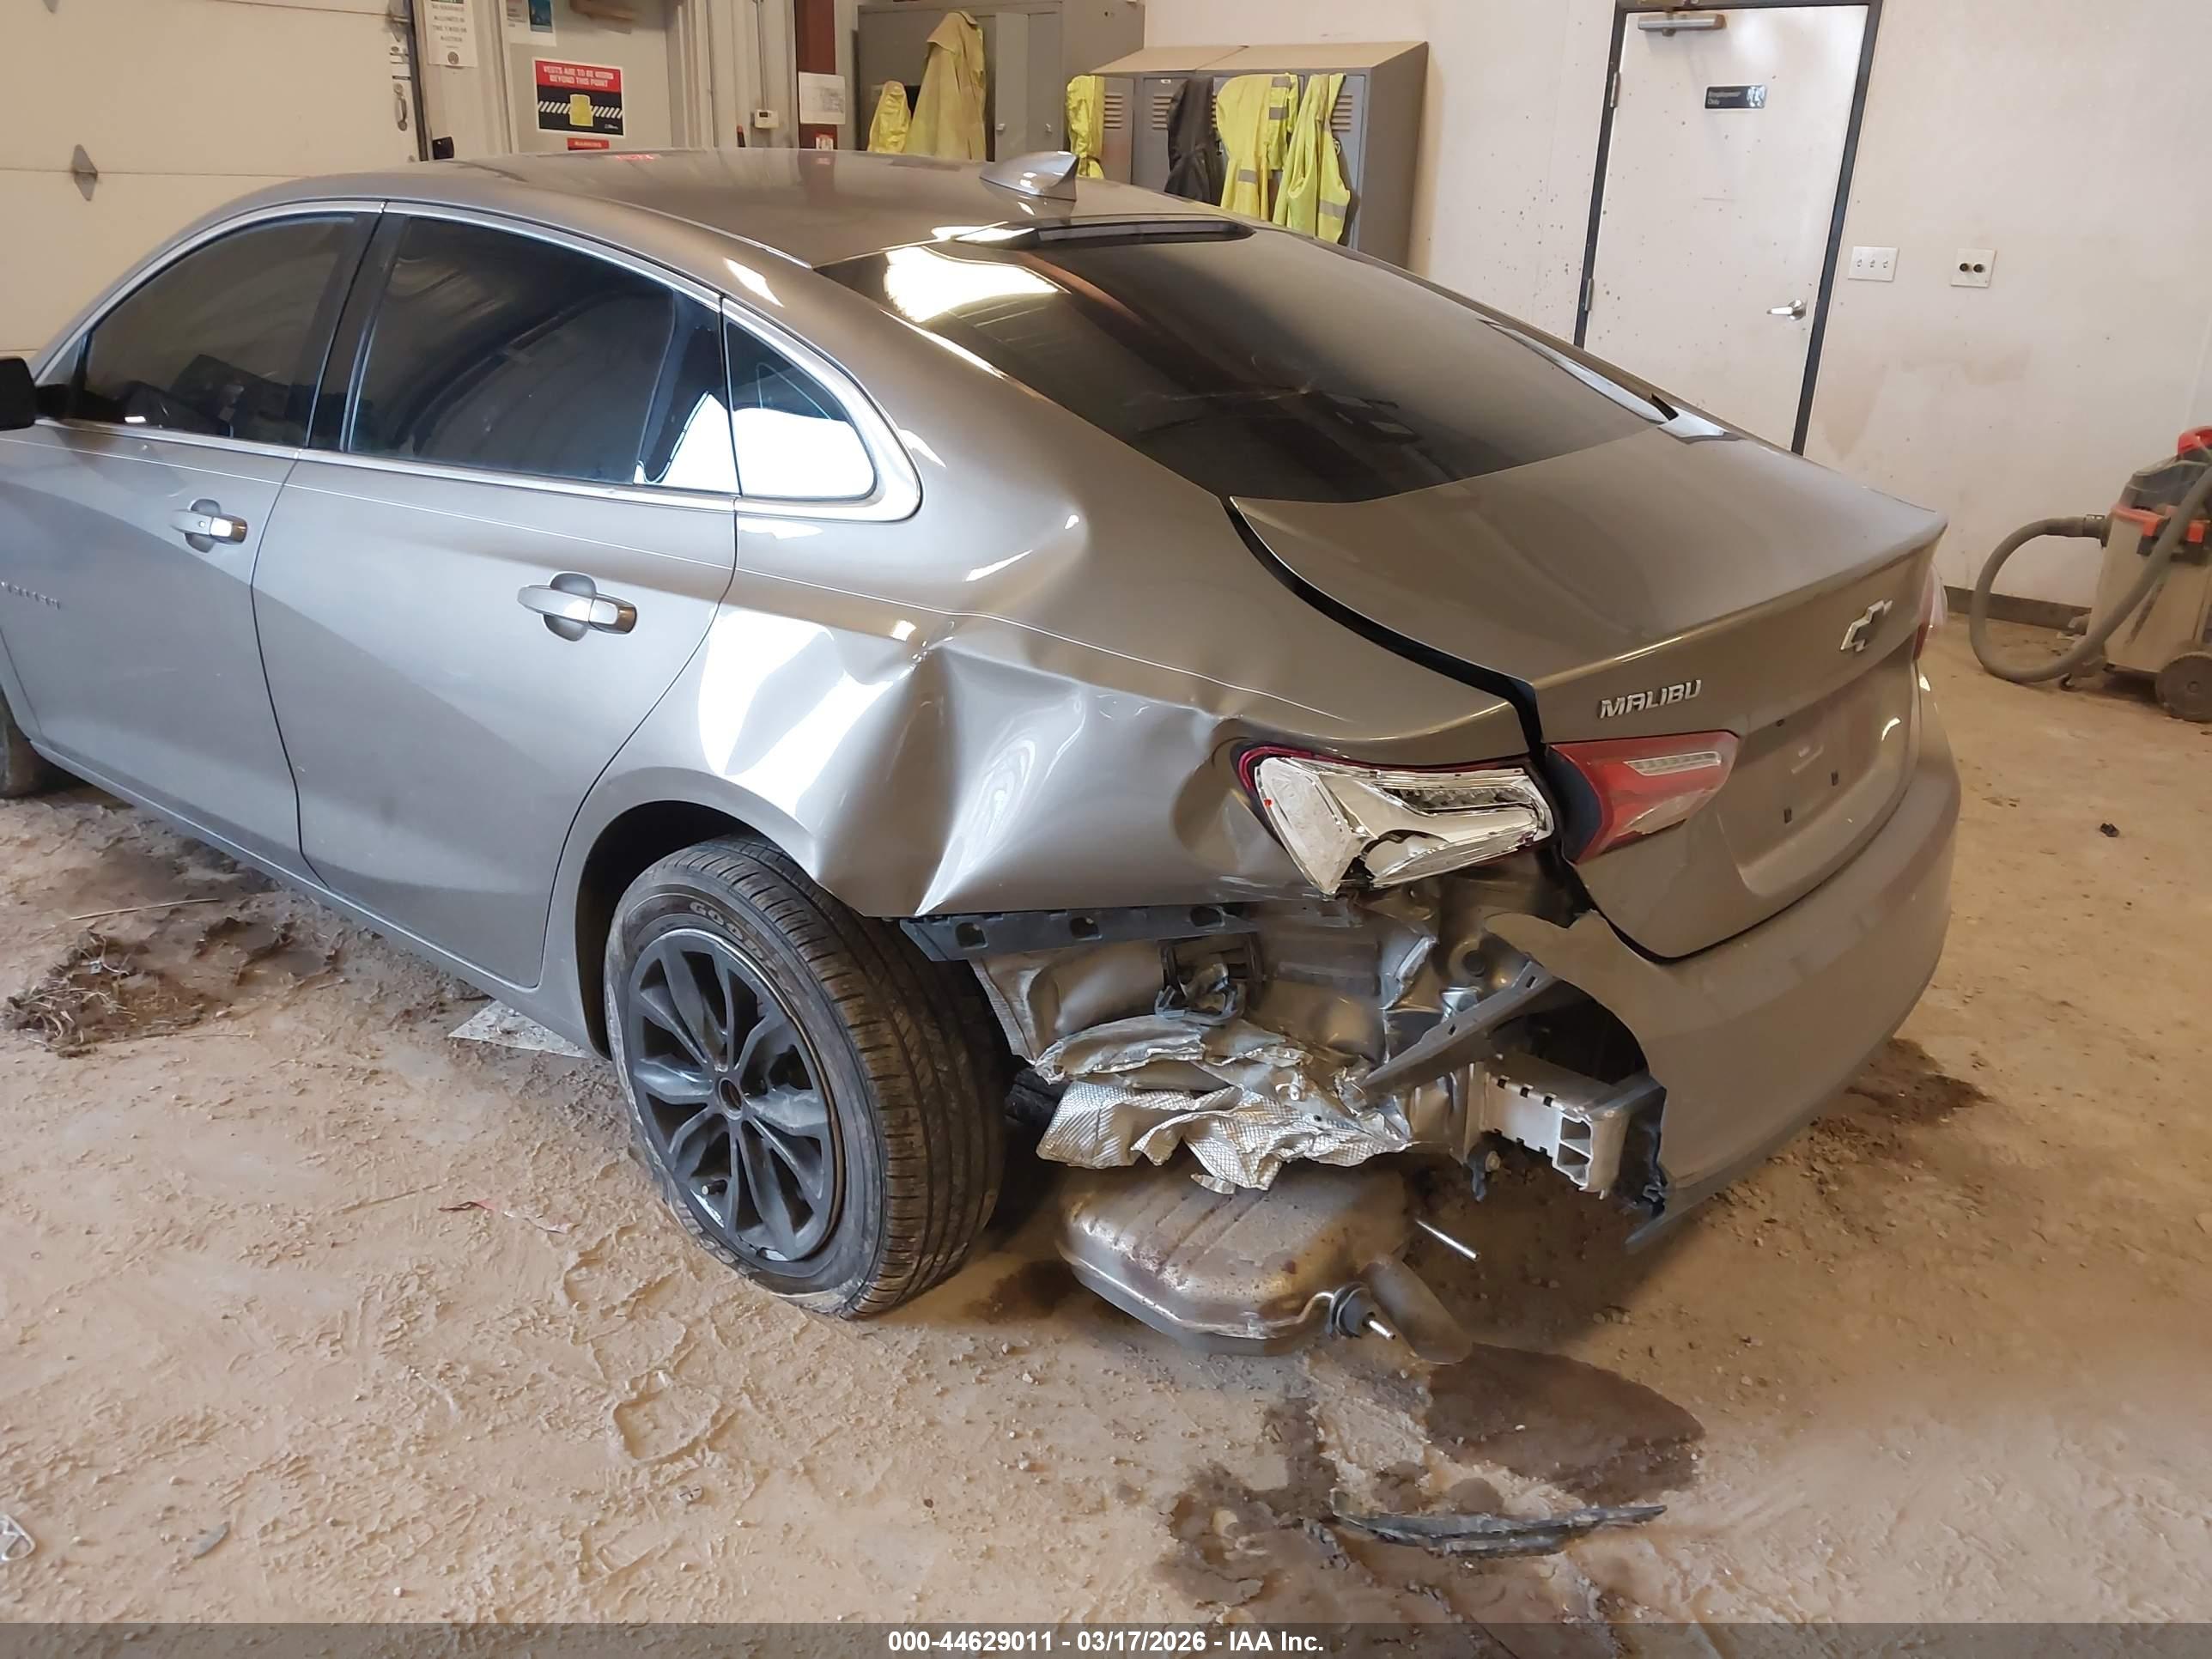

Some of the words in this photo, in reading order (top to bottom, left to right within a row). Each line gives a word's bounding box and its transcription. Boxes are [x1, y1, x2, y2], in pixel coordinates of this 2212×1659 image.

[563, 67, 576, 76] ARE
[577, 69, 586, 77] TO
[550, 74, 575, 84] BEYOND
[576, 76, 590, 86] THIS
[590, 78, 608, 88] POINT
[1599, 679, 1702, 719] MALIBU
